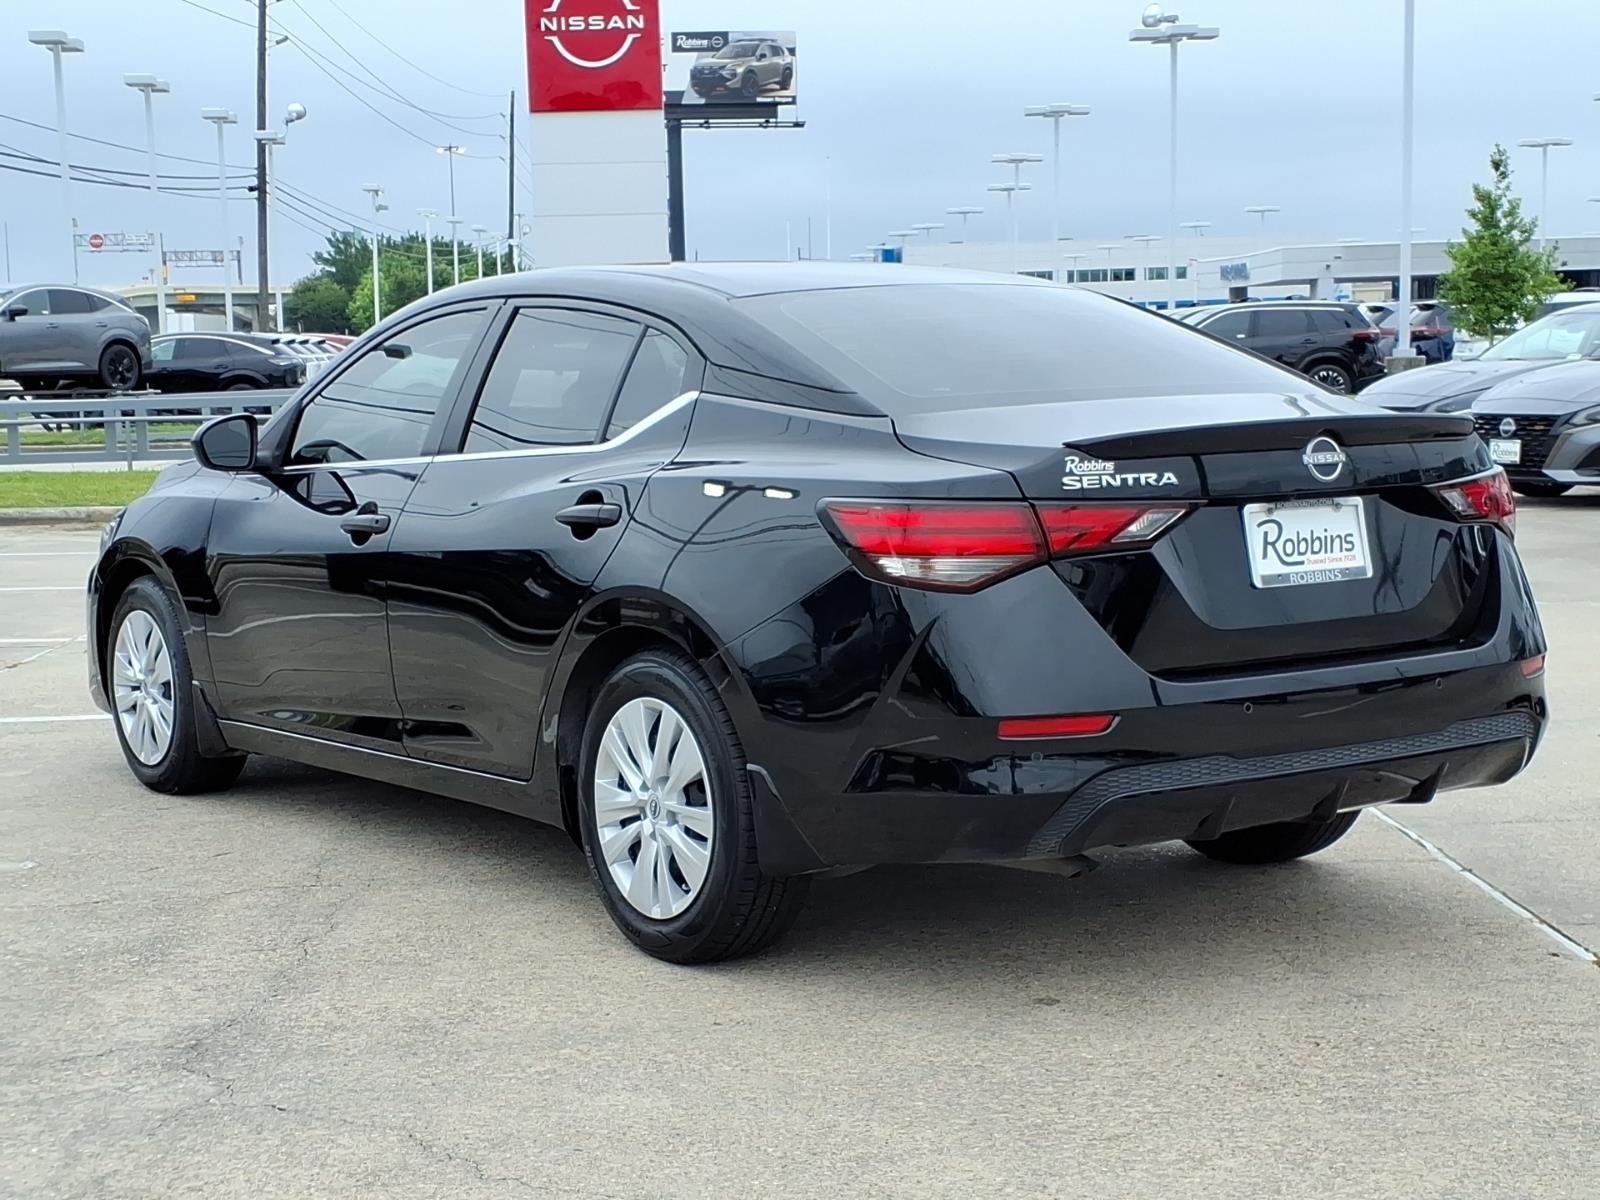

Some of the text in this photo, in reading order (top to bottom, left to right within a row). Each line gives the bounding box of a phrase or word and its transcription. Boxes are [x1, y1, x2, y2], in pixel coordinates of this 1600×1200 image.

[540, 14, 645, 32] NISSAN
[1064, 456, 1115, 475] Robbins
[1303, 454, 1346, 465] NISSAN
[1062, 472, 1179, 490] SENTRA
[1256, 518, 1355, 567] Robbins
[1289, 569, 1342, 584] ROBBINS
